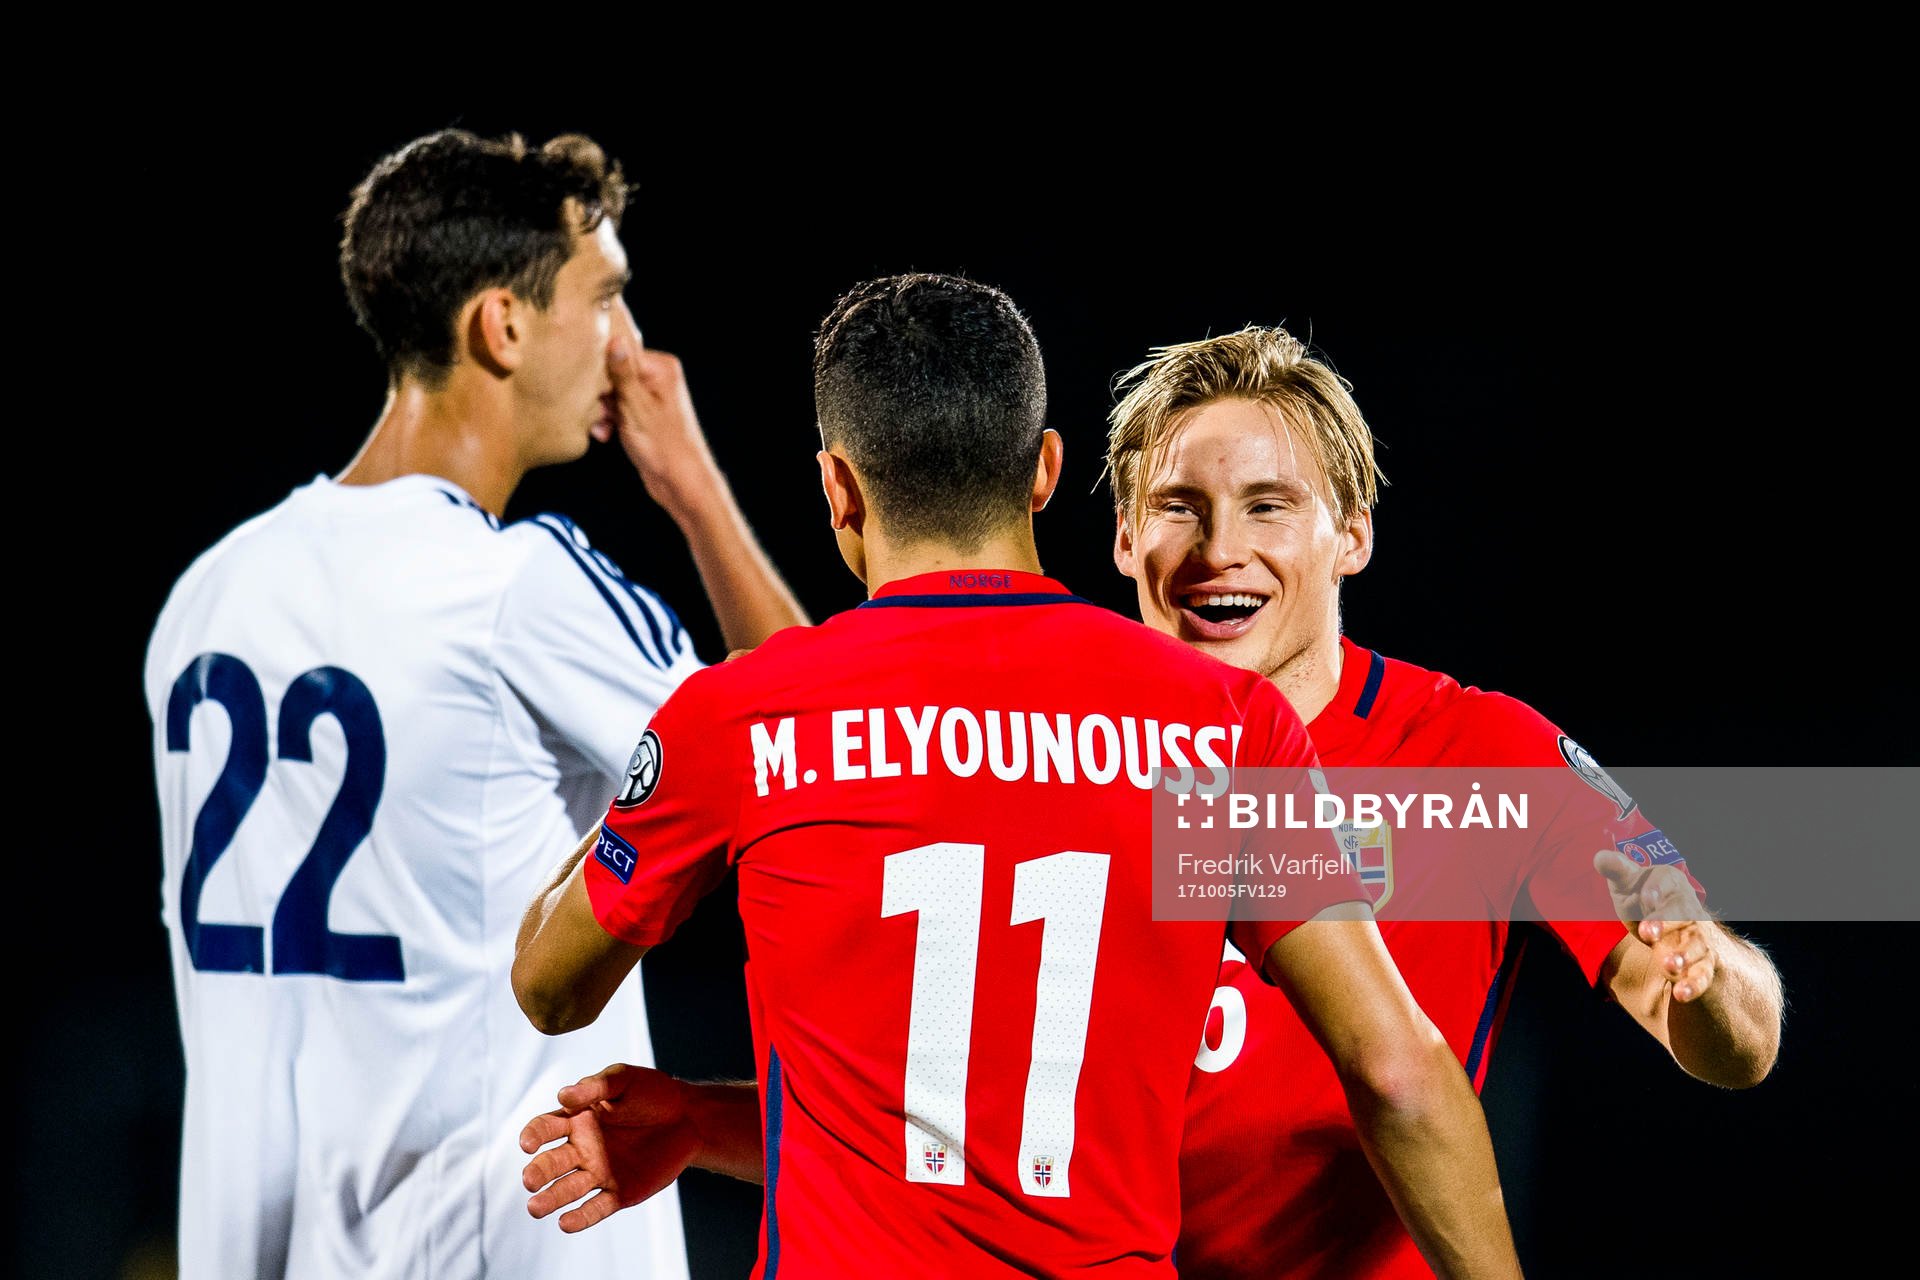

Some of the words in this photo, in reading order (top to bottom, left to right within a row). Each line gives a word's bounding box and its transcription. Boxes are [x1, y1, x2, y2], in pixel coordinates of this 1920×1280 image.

[949, 574, 1012, 588] NORGE
[750, 717, 817, 797] M.
[166, 652, 406, 983] 22
[1338, 822, 1362, 833] NOR
[880, 841, 1111, 1198] 11
